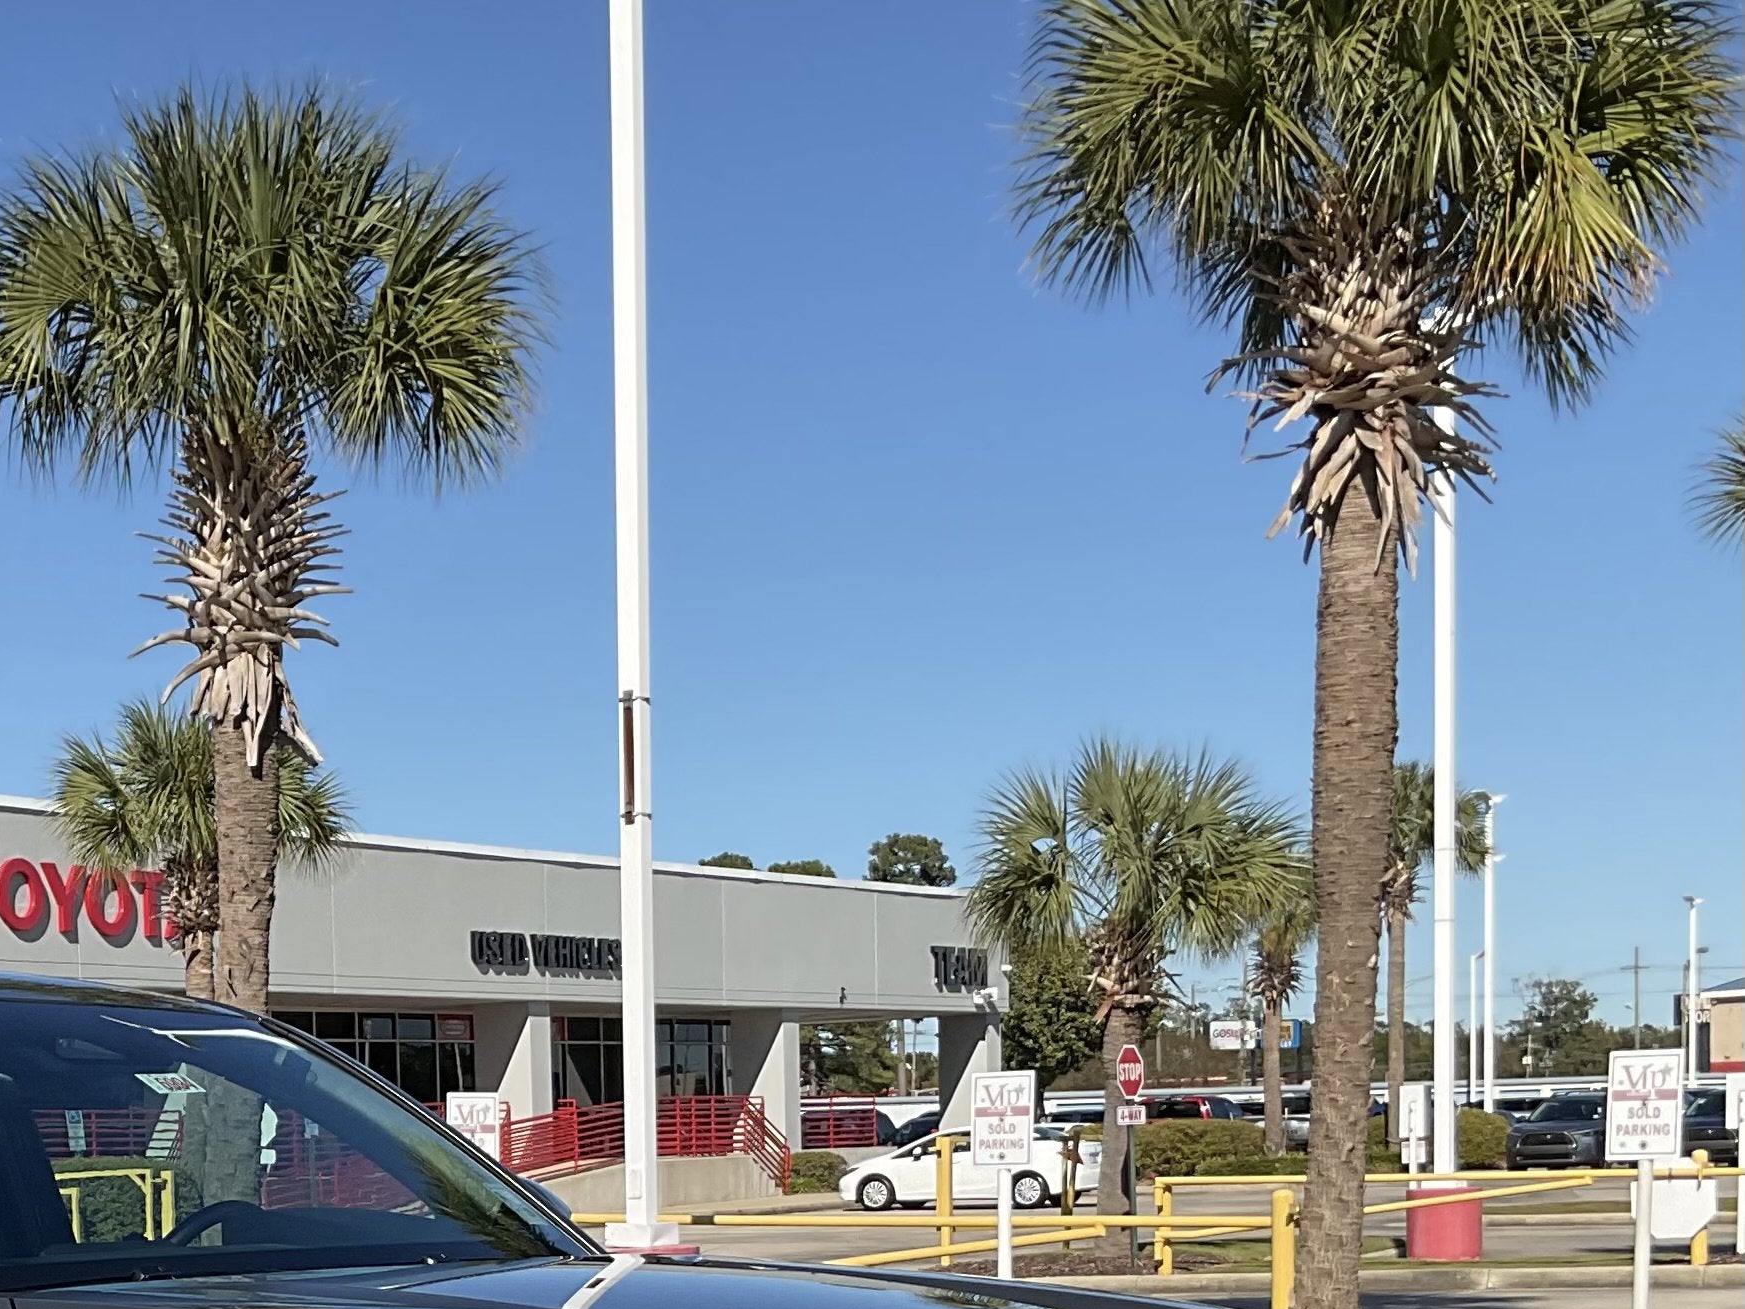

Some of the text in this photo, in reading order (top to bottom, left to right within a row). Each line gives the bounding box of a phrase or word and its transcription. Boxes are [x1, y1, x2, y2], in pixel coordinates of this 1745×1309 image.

[470, 930, 623, 972] USED VEHICLES
[930, 945, 989, 988] TEAM
[1119, 1062, 1142, 1082] STOP
[1120, 1109, 1143, 1122] 4-WAY
[1627, 1106, 1661, 1120] SOLD
[987, 1122, 1016, 1135] SOLD
[1616, 1123, 1671, 1137] PARKING
[978, 1138, 1025, 1150] PARKING
